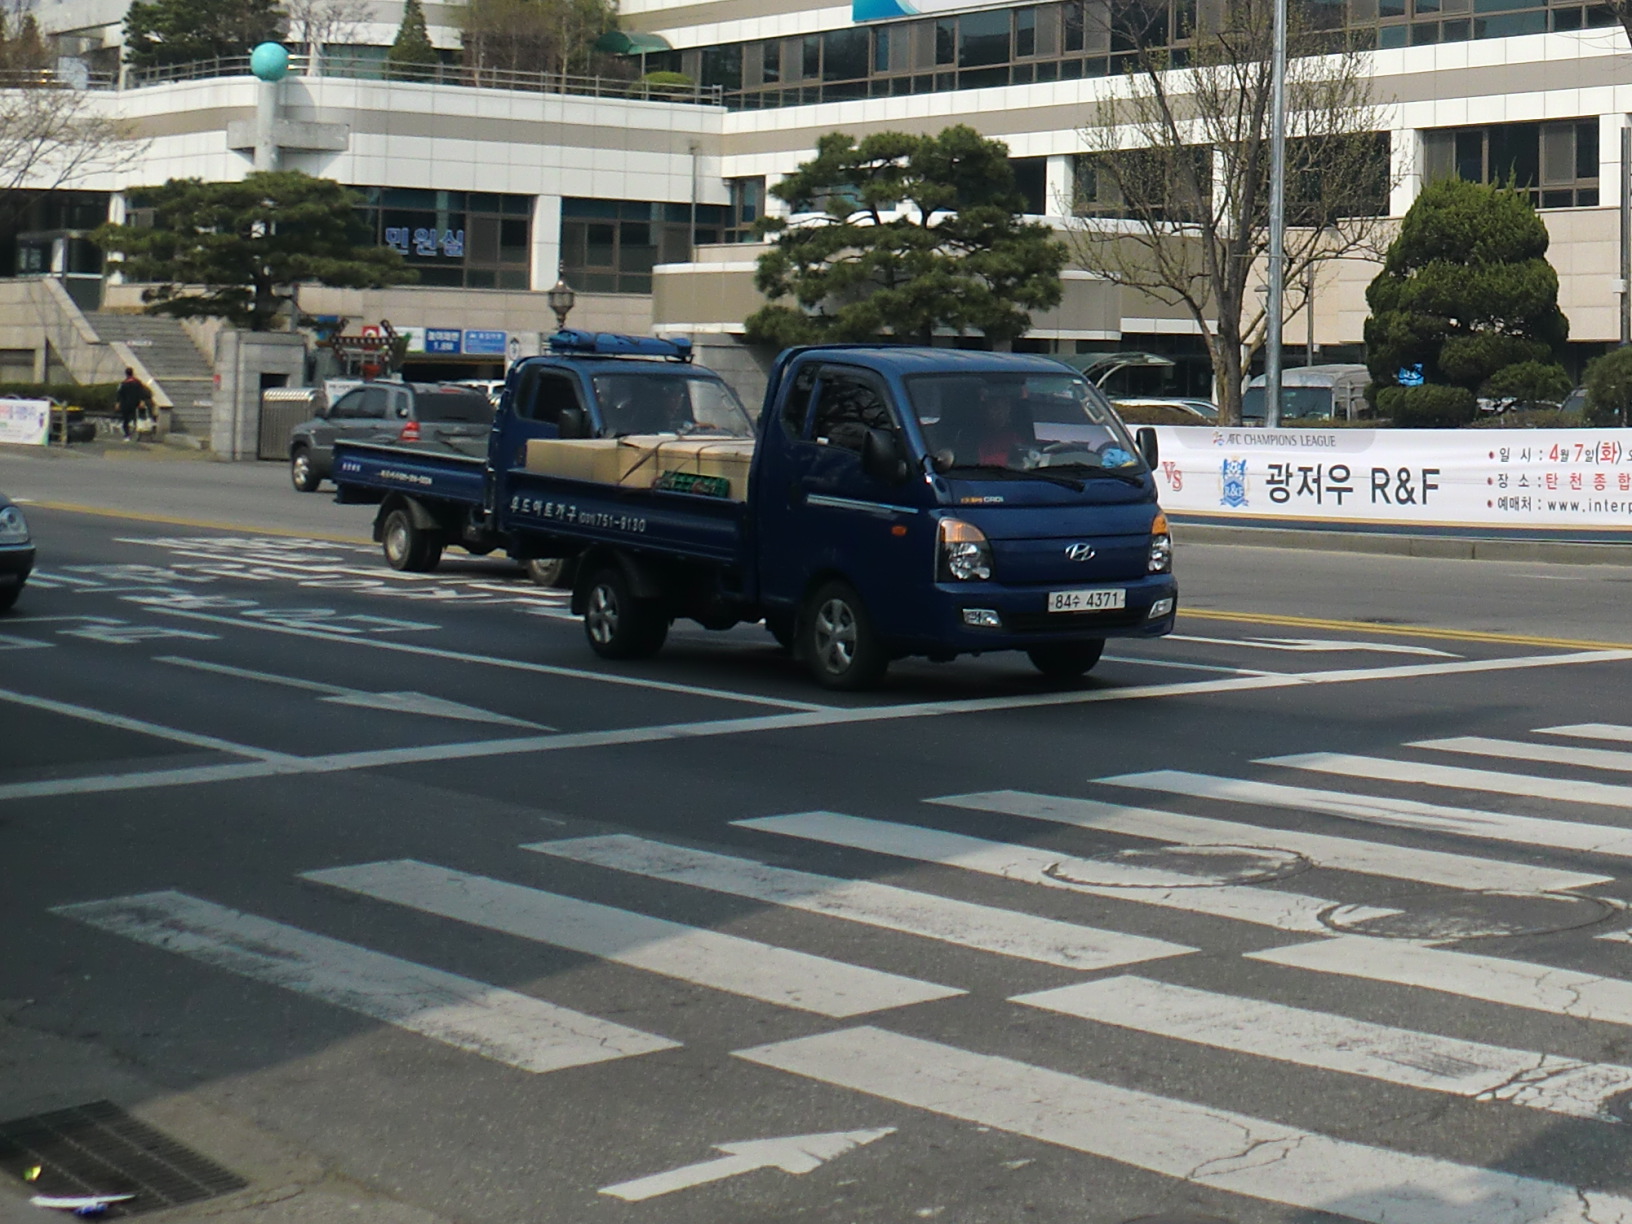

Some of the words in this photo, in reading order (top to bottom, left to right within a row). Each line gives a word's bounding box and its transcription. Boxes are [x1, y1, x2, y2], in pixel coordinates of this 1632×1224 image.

[385, 227, 464, 257] 민원실
[1226, 433, 1241, 446] AFC
[1244, 433, 1297, 447] CHAMPIONS
[1300, 434, 1337, 447] LEAGUE
[1265, 463, 1354, 505] 광저우
[1371, 467, 1441, 505] R&F
[1087, 592, 1118, 608] 4371
